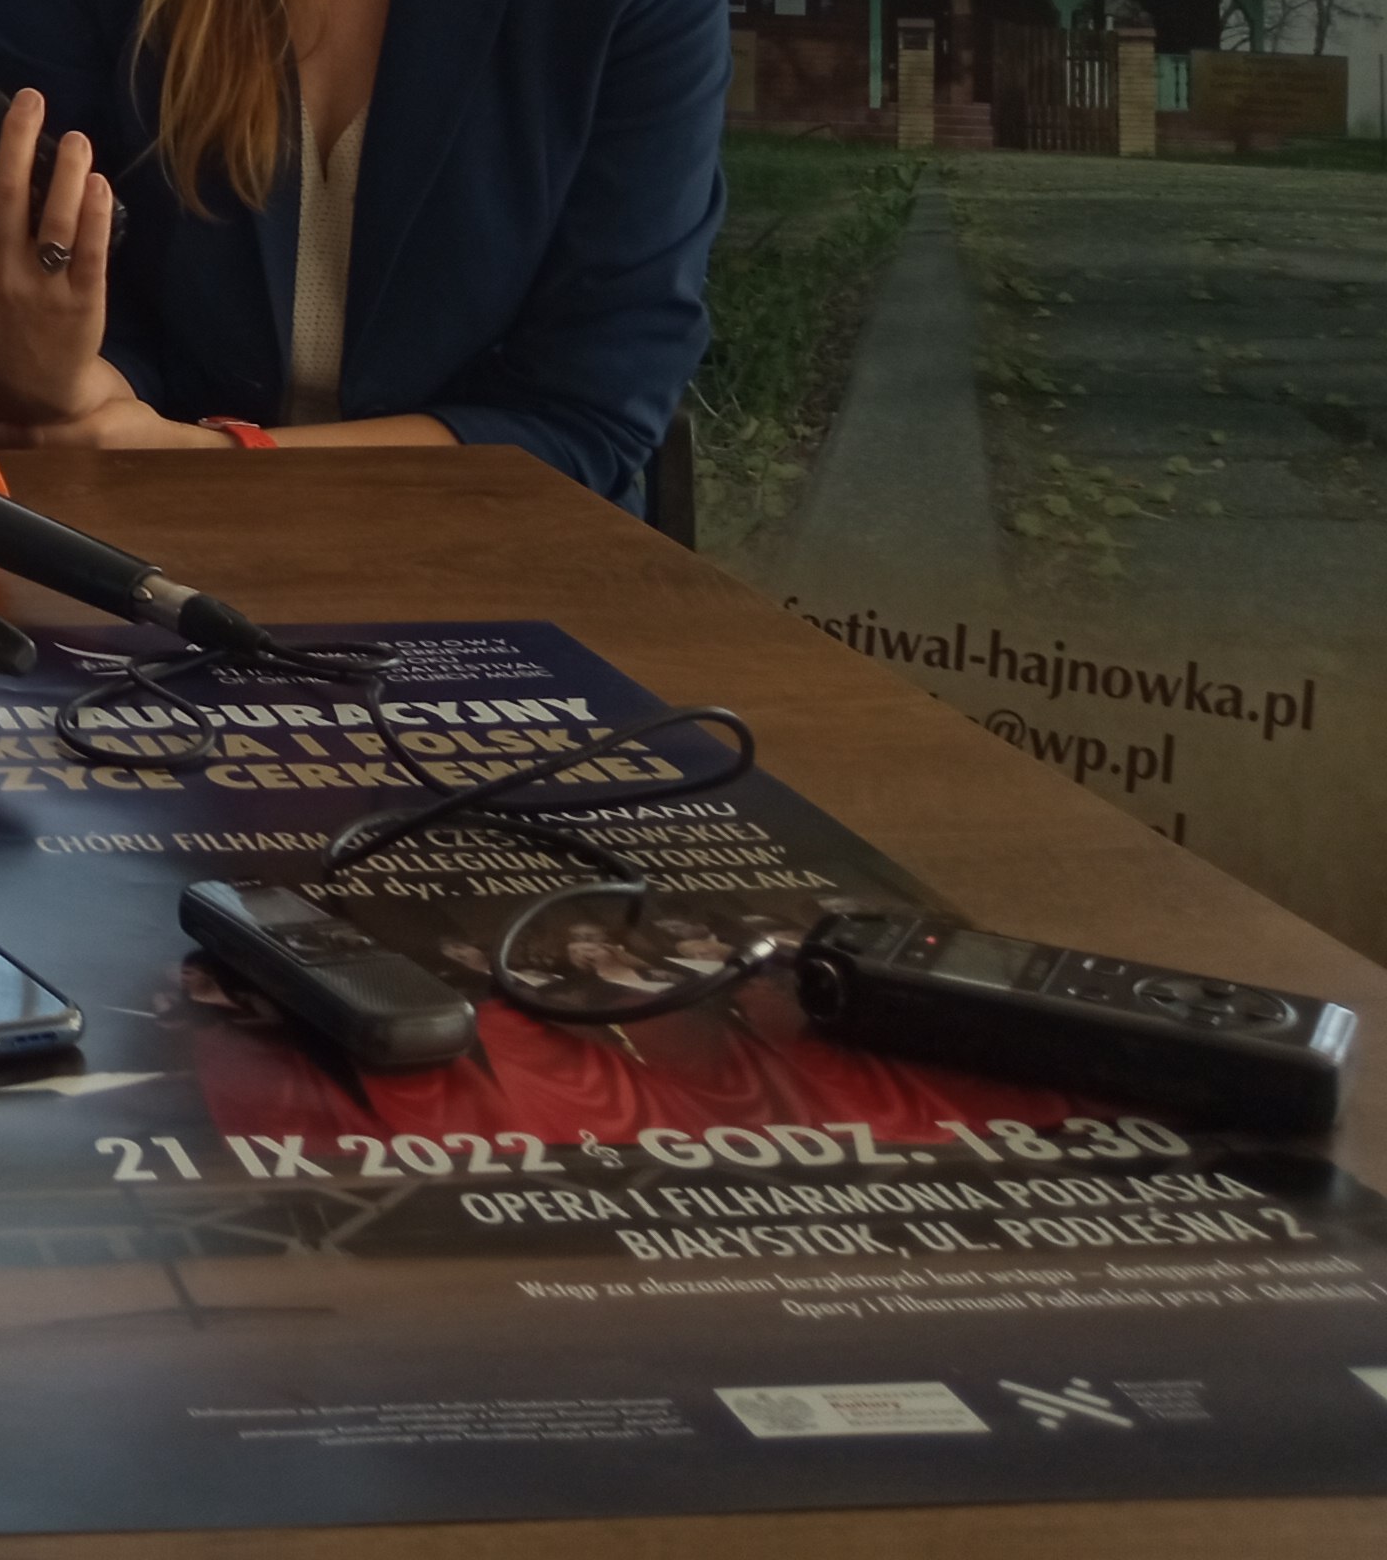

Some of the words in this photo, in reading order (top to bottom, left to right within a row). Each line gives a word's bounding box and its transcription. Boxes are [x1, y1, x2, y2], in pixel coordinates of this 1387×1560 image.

[398, 645, 521, 657] ERKIEWNEJ
[783, 596, 1316, 741] stiwal-hajnowka.pl
[290, 733, 331, 757] I
[36, 831, 165, 855] CHÓRU
[300, 876, 375, 901] pod
[384, 876, 462, 901] dyr.
[94, 1135, 202, 1182] 21
[225, 1134, 334, 1179] IX
[337, 1131, 567, 1178] 2022
[638, 1123, 938, 1170] GODZ.
[934, 1116, 1192, 1163] 18.30
[460, 1187, 629, 1226] OPERA
[626, 1187, 661, 1218] I
[659, 1181, 994, 1219] FILHARMONIA
[995, 1171, 1266, 1211] PODLASKA
[614, 1223, 913, 1261] BIAŁYSTOK,
[915, 1220, 1002, 1253] UL.
[995, 1206, 1267, 1250] PODLEŚNA
[1257, 1206, 1318, 1241] 2
